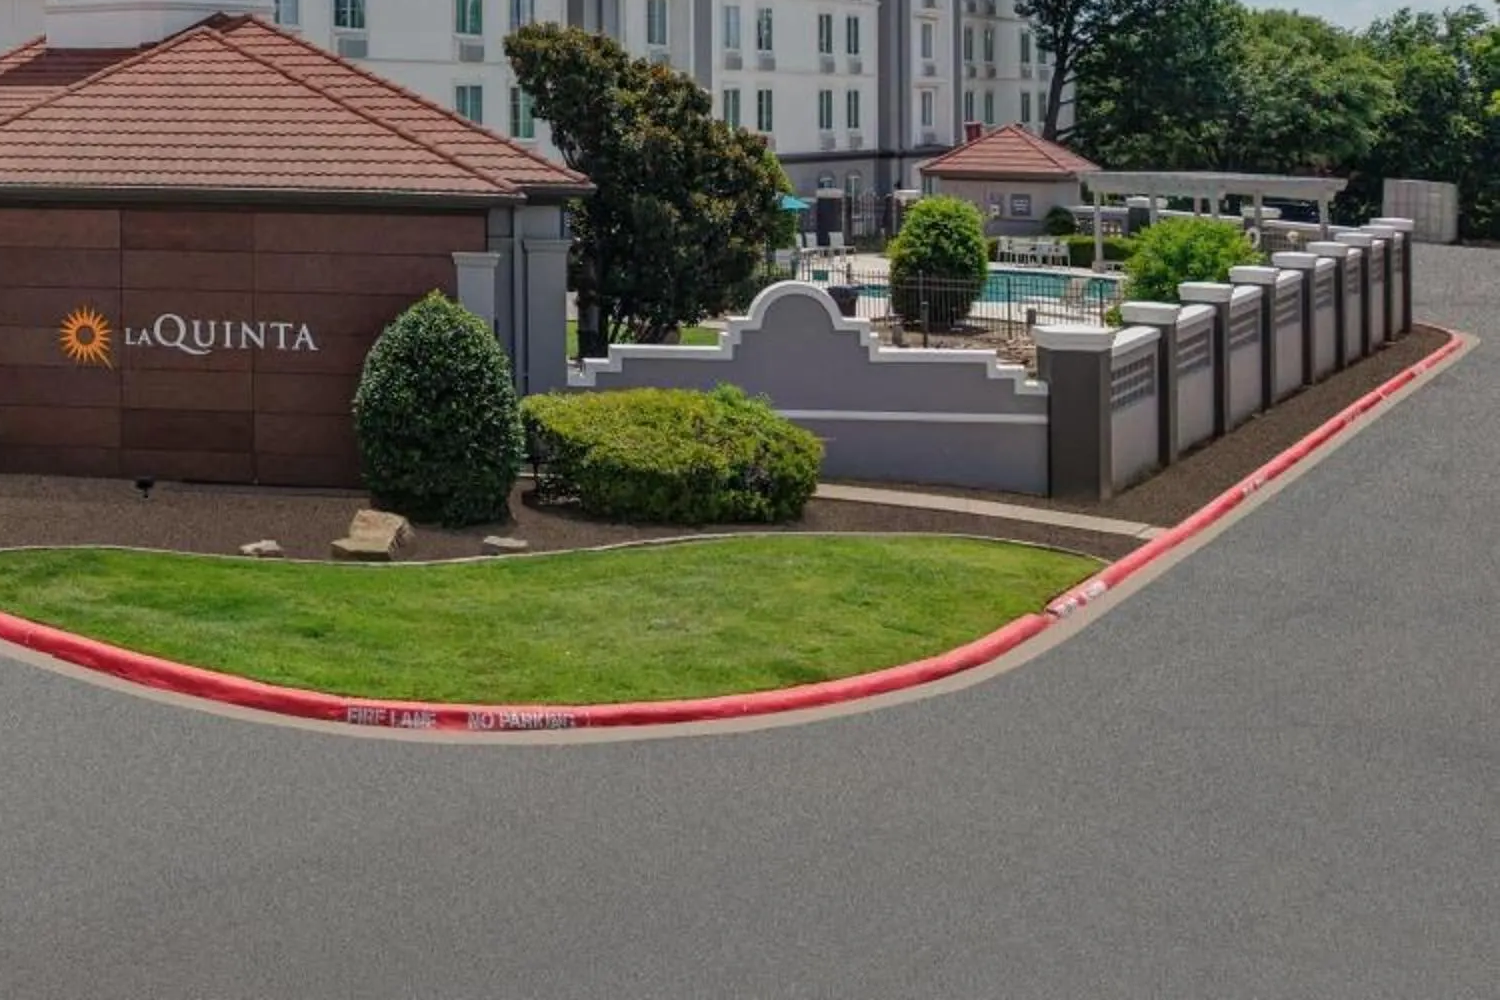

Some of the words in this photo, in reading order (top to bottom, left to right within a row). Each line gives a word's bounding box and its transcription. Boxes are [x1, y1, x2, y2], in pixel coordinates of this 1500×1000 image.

[347, 706, 387, 726] FIRE
[391, 709, 437, 730] LANE
[467, 711, 494, 730] NO
[499, 710, 576, 731] PARKING
